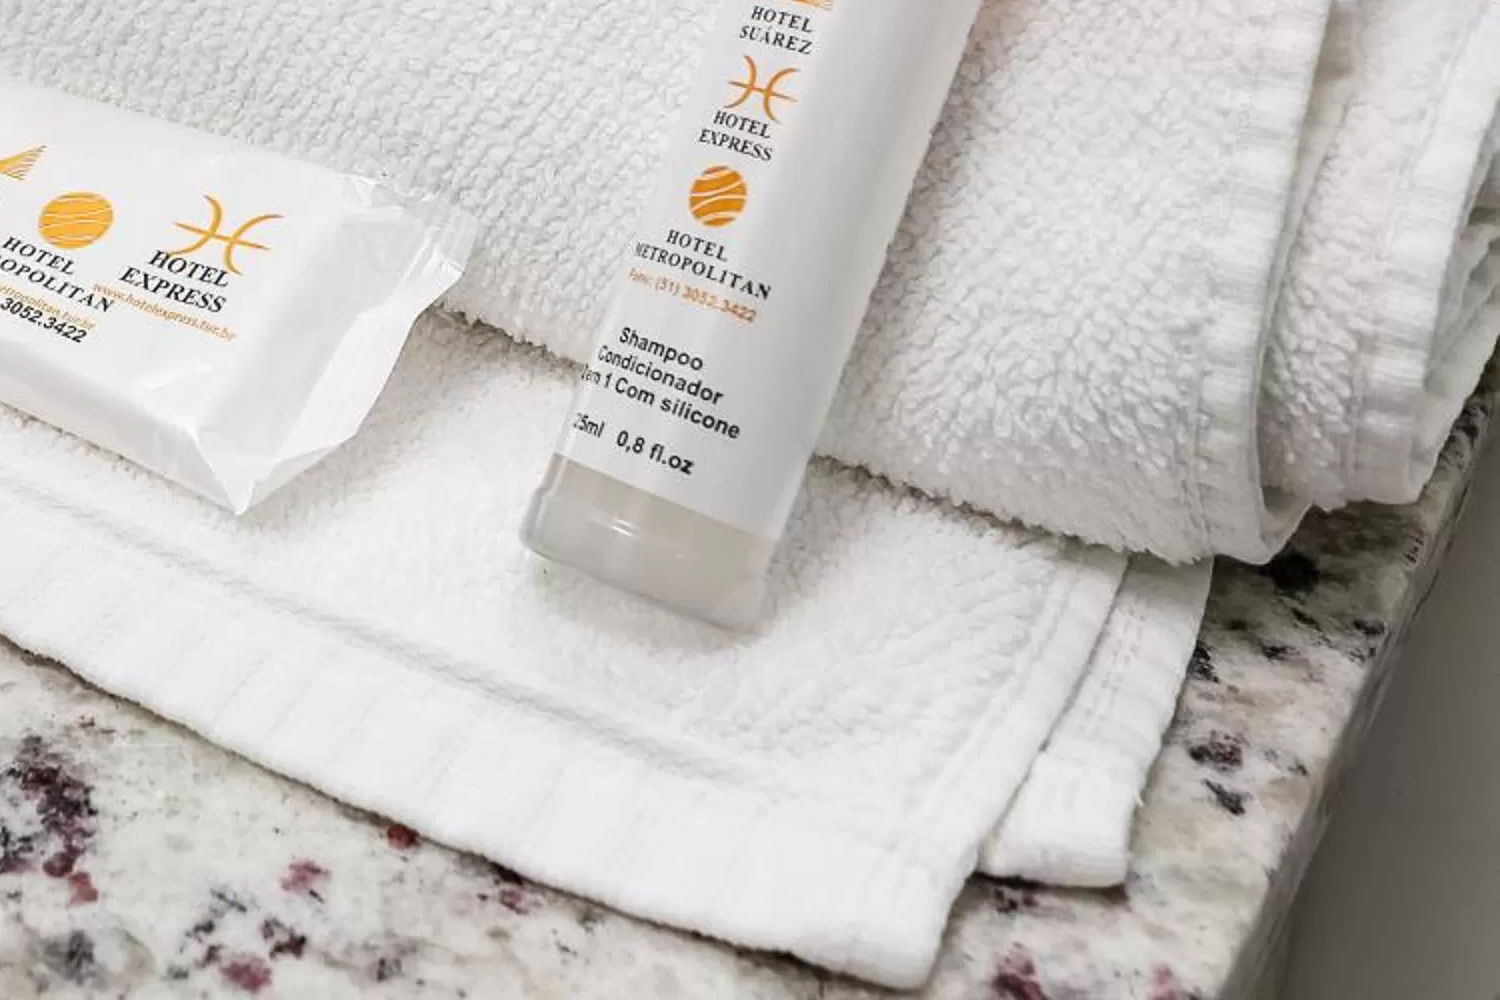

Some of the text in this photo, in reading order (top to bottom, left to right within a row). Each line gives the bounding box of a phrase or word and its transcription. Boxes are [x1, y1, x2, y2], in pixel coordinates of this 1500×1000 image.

[751, 5, 813, 33] HOTEL
[739, 25, 813, 55] SUÁREZ
[713, 110, 771, 139] HOTEL
[699, 128, 773, 161] EXPRESS
[2, 236, 76, 275] HOTEL
[666, 229, 728, 262] HOTEL
[148, 249, 230, 287] HOTEL
[120, 266, 227, 313] EXPRESS
[0, 297, 88, 343] 3052.3422
[619, 327, 703, 371] Shampoo
[597, 344, 724, 405] Condicionador
[603, 372, 613, 388] 1
[615, 377, 655, 406] Com
[660, 398, 740, 439] silicone
[616, 430, 645, 455] 0,8
[649, 443, 695, 475] fl.oz
